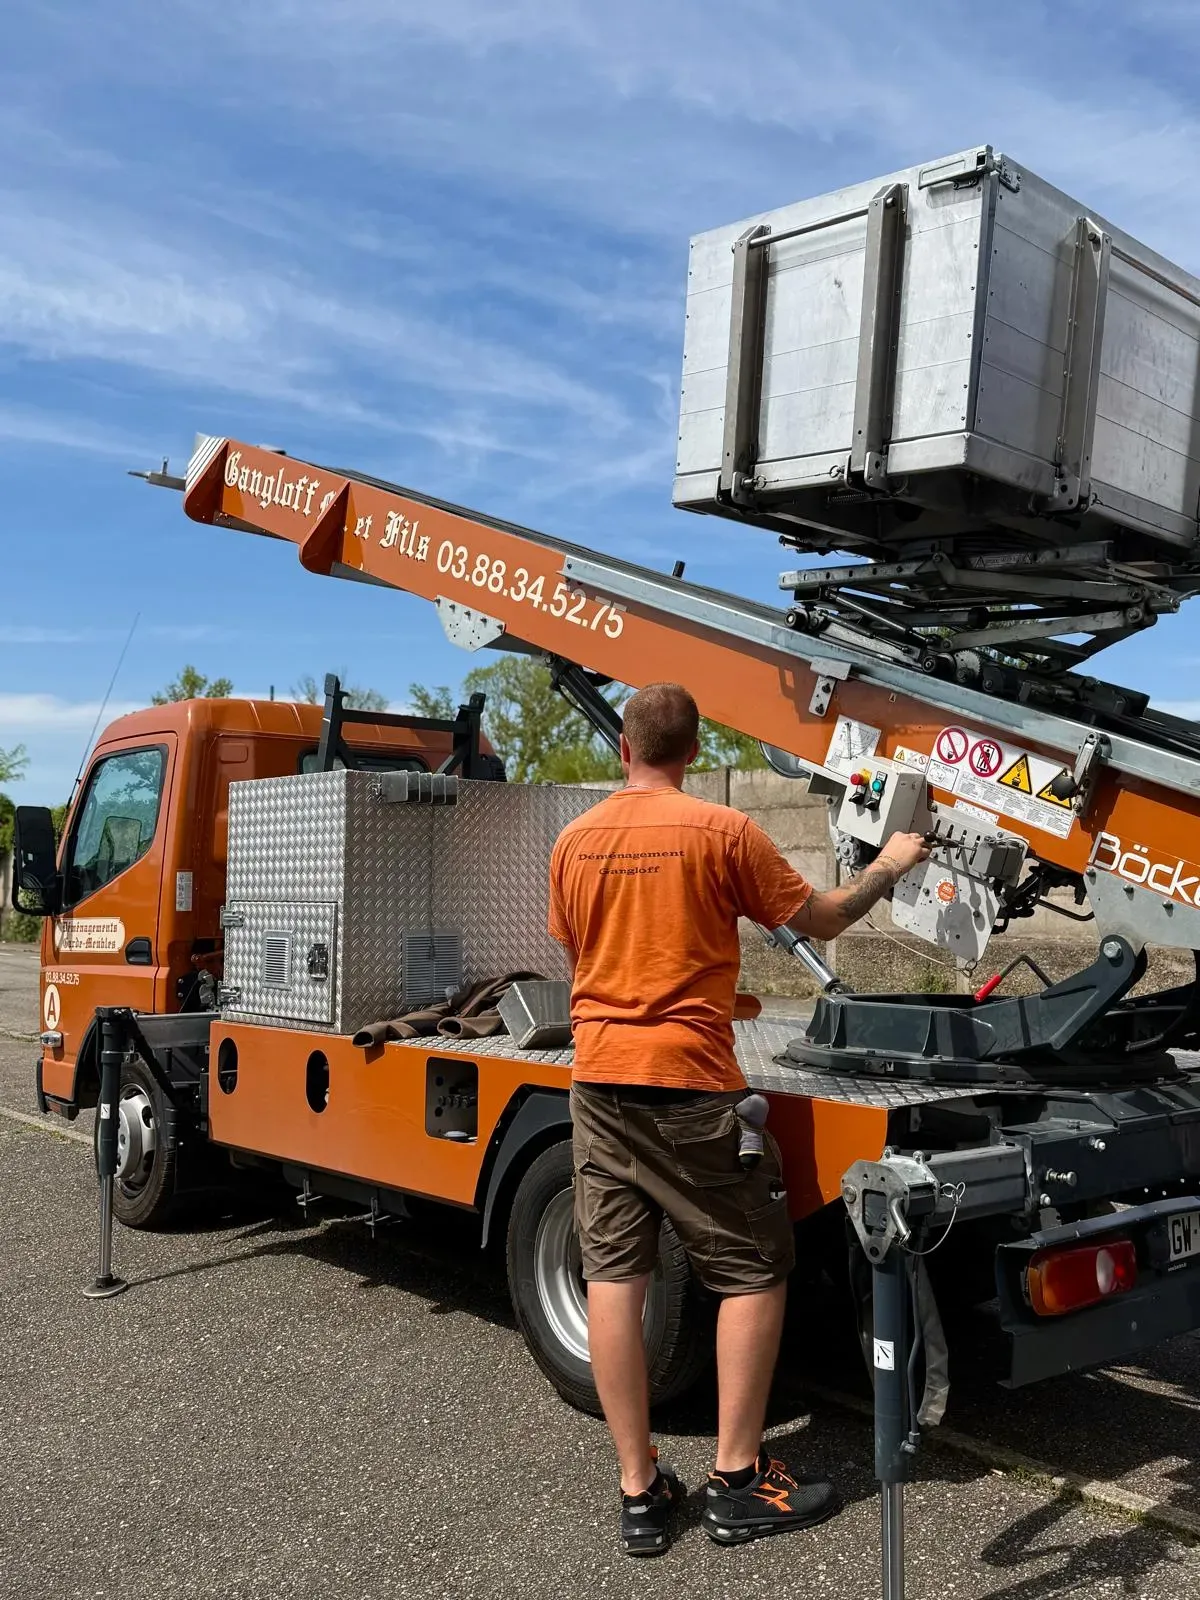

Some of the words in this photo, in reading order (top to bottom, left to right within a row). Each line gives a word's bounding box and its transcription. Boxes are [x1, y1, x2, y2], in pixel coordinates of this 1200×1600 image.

[224, 451, 320, 516] Gangloff
[354, 514, 373, 540] et
[379, 511, 431, 561] Fils
[437, 540, 624, 639] 03.88.34.52.75
[578, 850, 685, 860] Déménagement
[1088, 831, 1200, 906] Böck
[598, 866, 660, 875] Gangloff
[47, 992, 57, 1022] A
